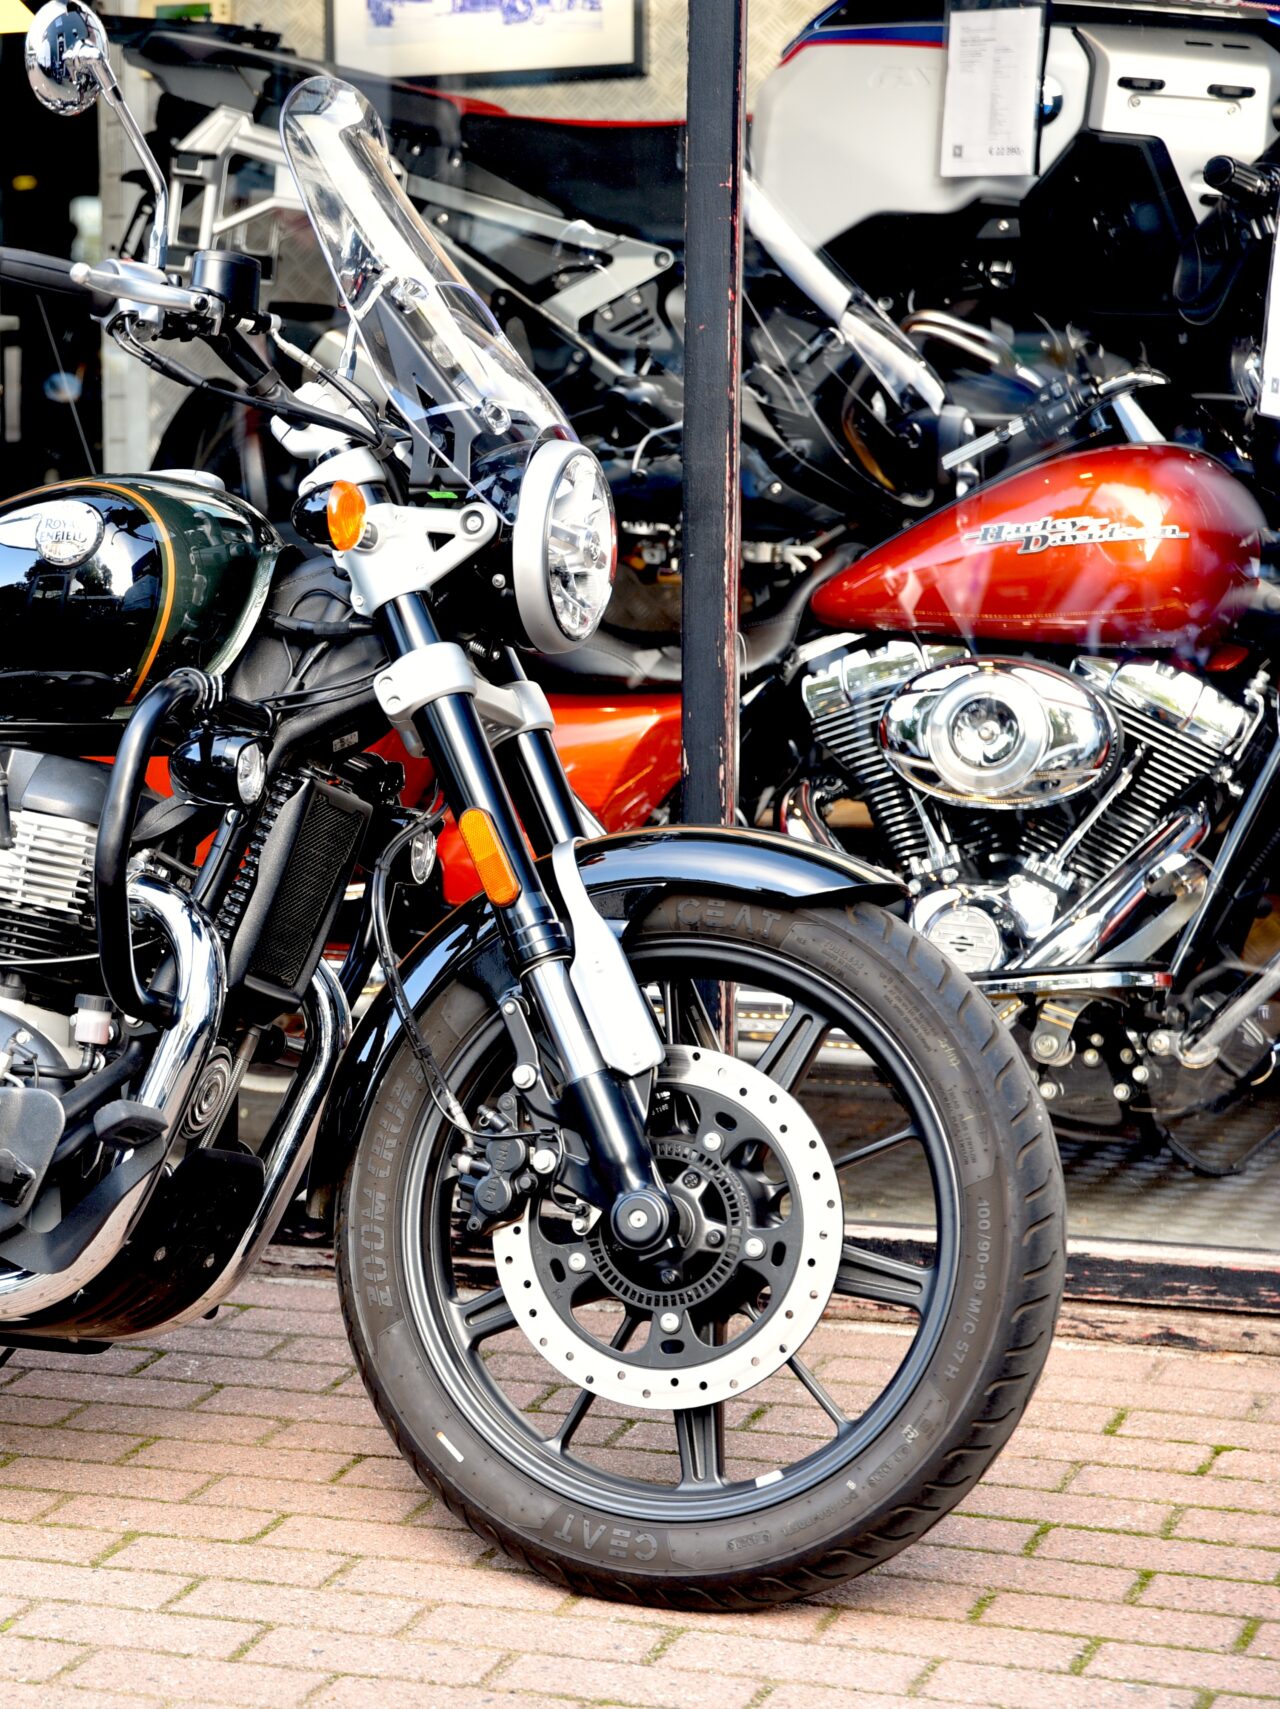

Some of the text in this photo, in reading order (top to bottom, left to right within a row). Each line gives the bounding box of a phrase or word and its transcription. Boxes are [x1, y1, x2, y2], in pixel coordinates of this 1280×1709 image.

[677, 898, 782, 939] CEAT
[367, 1075, 417, 1179] CRUZ
[360, 1188, 394, 1308] ZOOM
[972, 1199, 992, 1291] 100/90-19
[963, 1299, 985, 1335] M/C
[553, 1513, 659, 1562] CEAT
